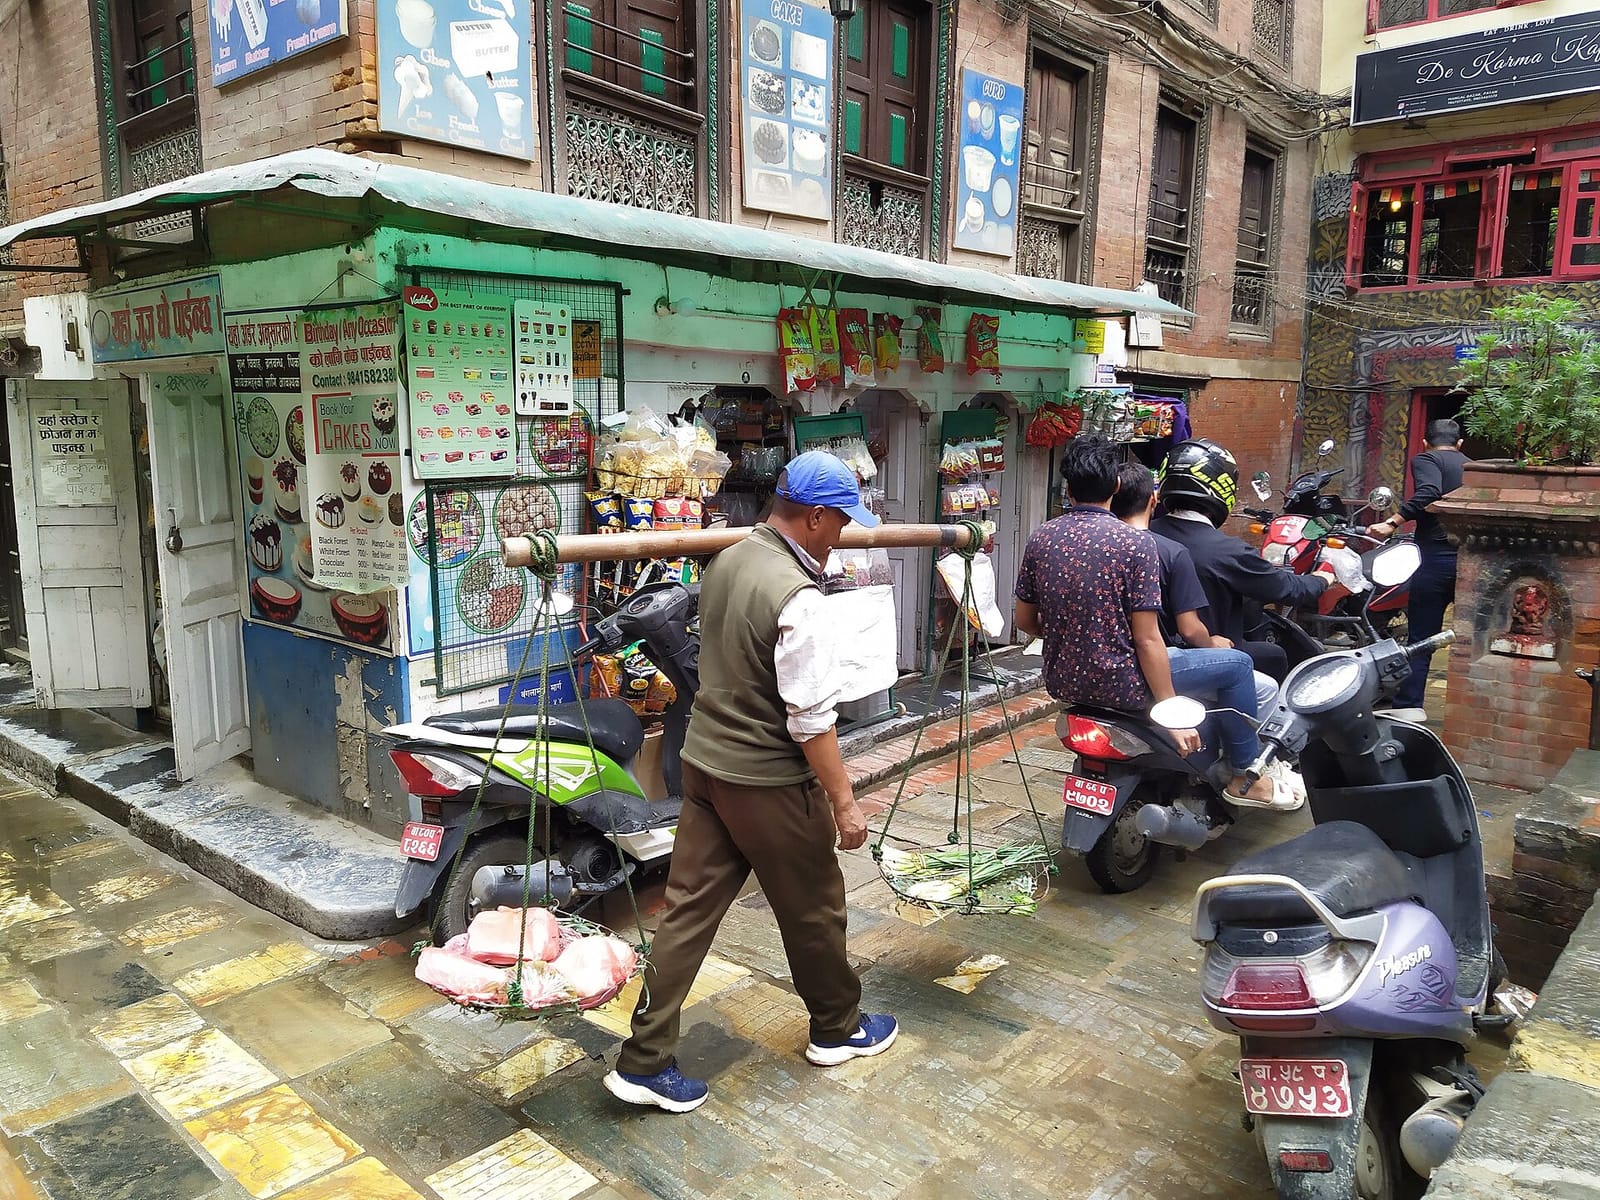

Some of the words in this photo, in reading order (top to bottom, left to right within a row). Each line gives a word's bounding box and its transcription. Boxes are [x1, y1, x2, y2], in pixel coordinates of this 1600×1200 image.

[771, 0, 803, 26] CAKE
[455, 23, 493, 32] BUTTER
[1483, 28, 1498, 37] EAT
[1504, 23, 1529, 33] DRINK
[1535, 18, 1556, 27] LOVE
[1416, 62, 1454, 84] De
[1459, 47, 1544, 80] Karma
[982, 79, 1006, 100] CURD
[312, 371, 342, 388] Contact
[320, 403, 338, 416] Book
[91, 415, 100, 425] र
[322, 418, 372, 450] CAKES
[374, 436, 397, 450] NOW
[318, 536, 334, 545] Black
[318, 547, 336, 556] White
[319, 558, 345, 567] Chocolate
[1311, 1065, 1327, 1081] प
[1250, 1085, 1342, 1114] ४७५३
